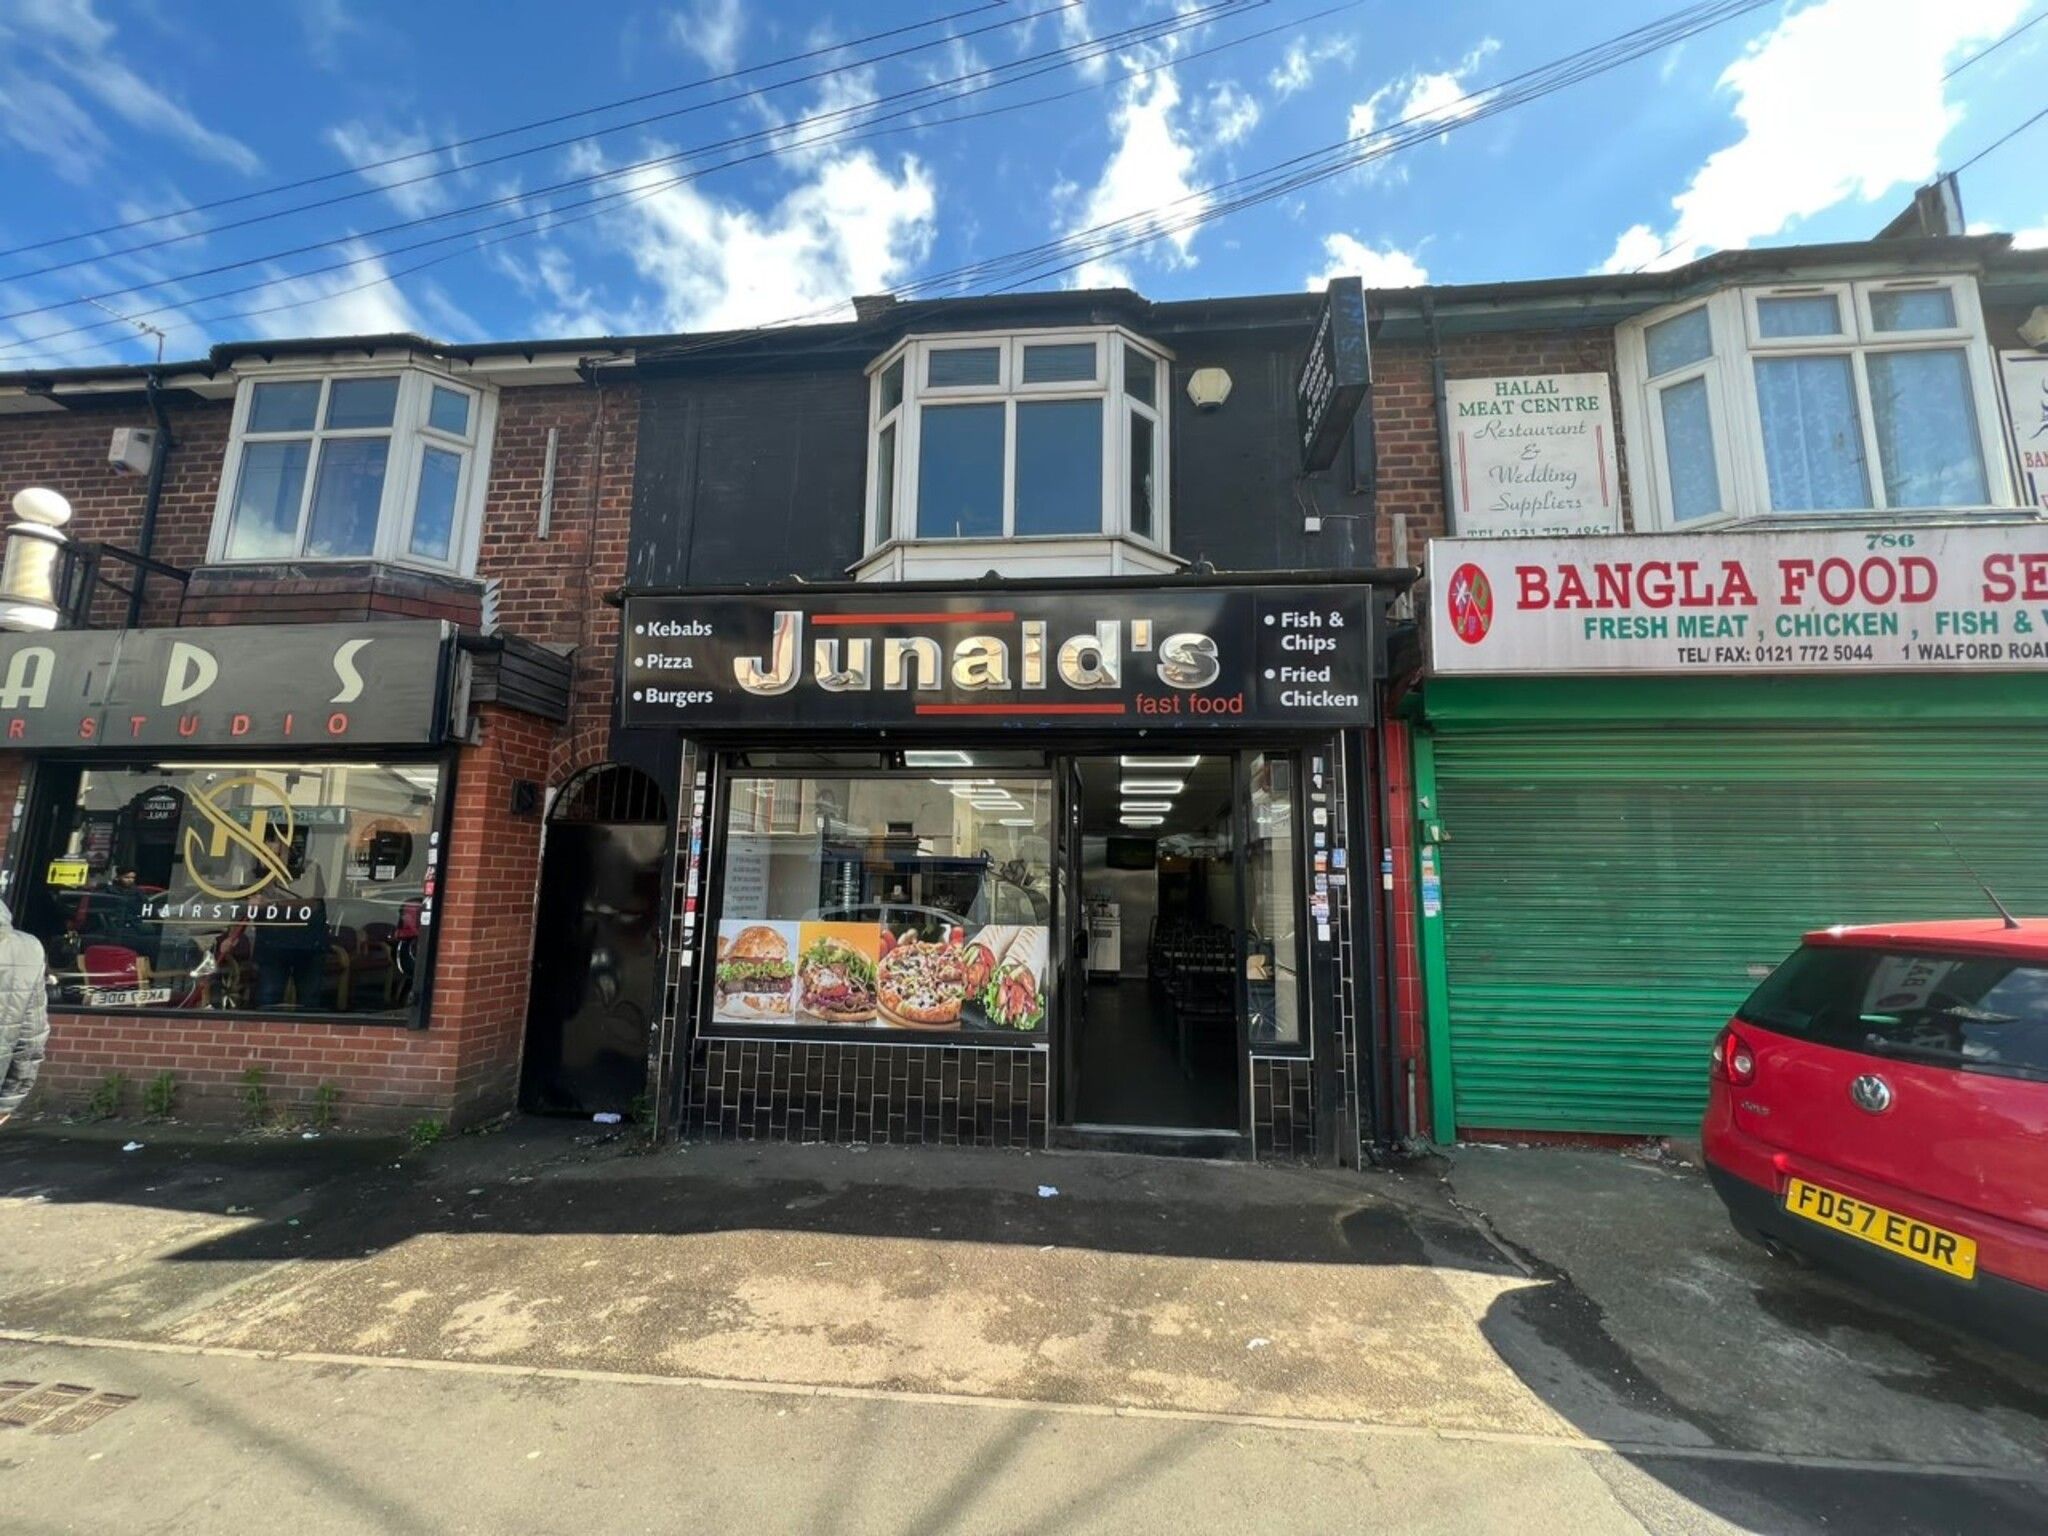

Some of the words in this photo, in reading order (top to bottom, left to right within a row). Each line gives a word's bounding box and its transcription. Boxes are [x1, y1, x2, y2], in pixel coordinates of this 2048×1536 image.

[1495, 379, 1559, 396] HALAL
[1458, 401, 1514, 416] MEAT
[1521, 396, 1600, 414] CENTRE
[1473, 420, 1588, 440] Restaurant
[1521, 443, 1541, 460] &
[1489, 463, 1577, 490] Wedding
[1490, 490, 1583, 518] Suppliers
[1865, 534, 1915, 550] 786
[1515, 560, 1758, 610] BANGLA
[1778, 556, 1938, 606] FOOD
[648, 620, 713, 636] Kebabs
[1281, 611, 1322, 628] Fish
[1329, 611, 1344, 627] &
[1584, 616, 1668, 640] FRESH
[1677, 614, 1748, 638] MEAT
[1775, 611, 1898, 638] CHICKEN
[1936, 610, 1999, 635] FISH
[2013, 609, 2033, 634] &
[732, 611, 1220, 696] Junaid's
[1281, 634, 1337, 655] Chips
[1715, 647, 1751, 662] FAX:
[1755, 646, 1793, 662] 0121
[1799, 645, 1828, 662] 772
[1834, 644, 1873, 660] 5044
[1901, 643, 1910, 660] 1
[1918, 643, 2002, 660] WALFORD
[647, 653, 693, 669] Pizza
[1281, 665, 1331, 682] Fried
[645, 687, 714, 708] Burgers
[1136, 693, 1181, 714] fast
[1189, 693, 1244, 714] food
[1280, 690, 1359, 707] Chicken
[80, 712, 350, 739] STUDIO
[1799, 1184, 1876, 1234] FD57
[1885, 1215, 1957, 1266] EOR
